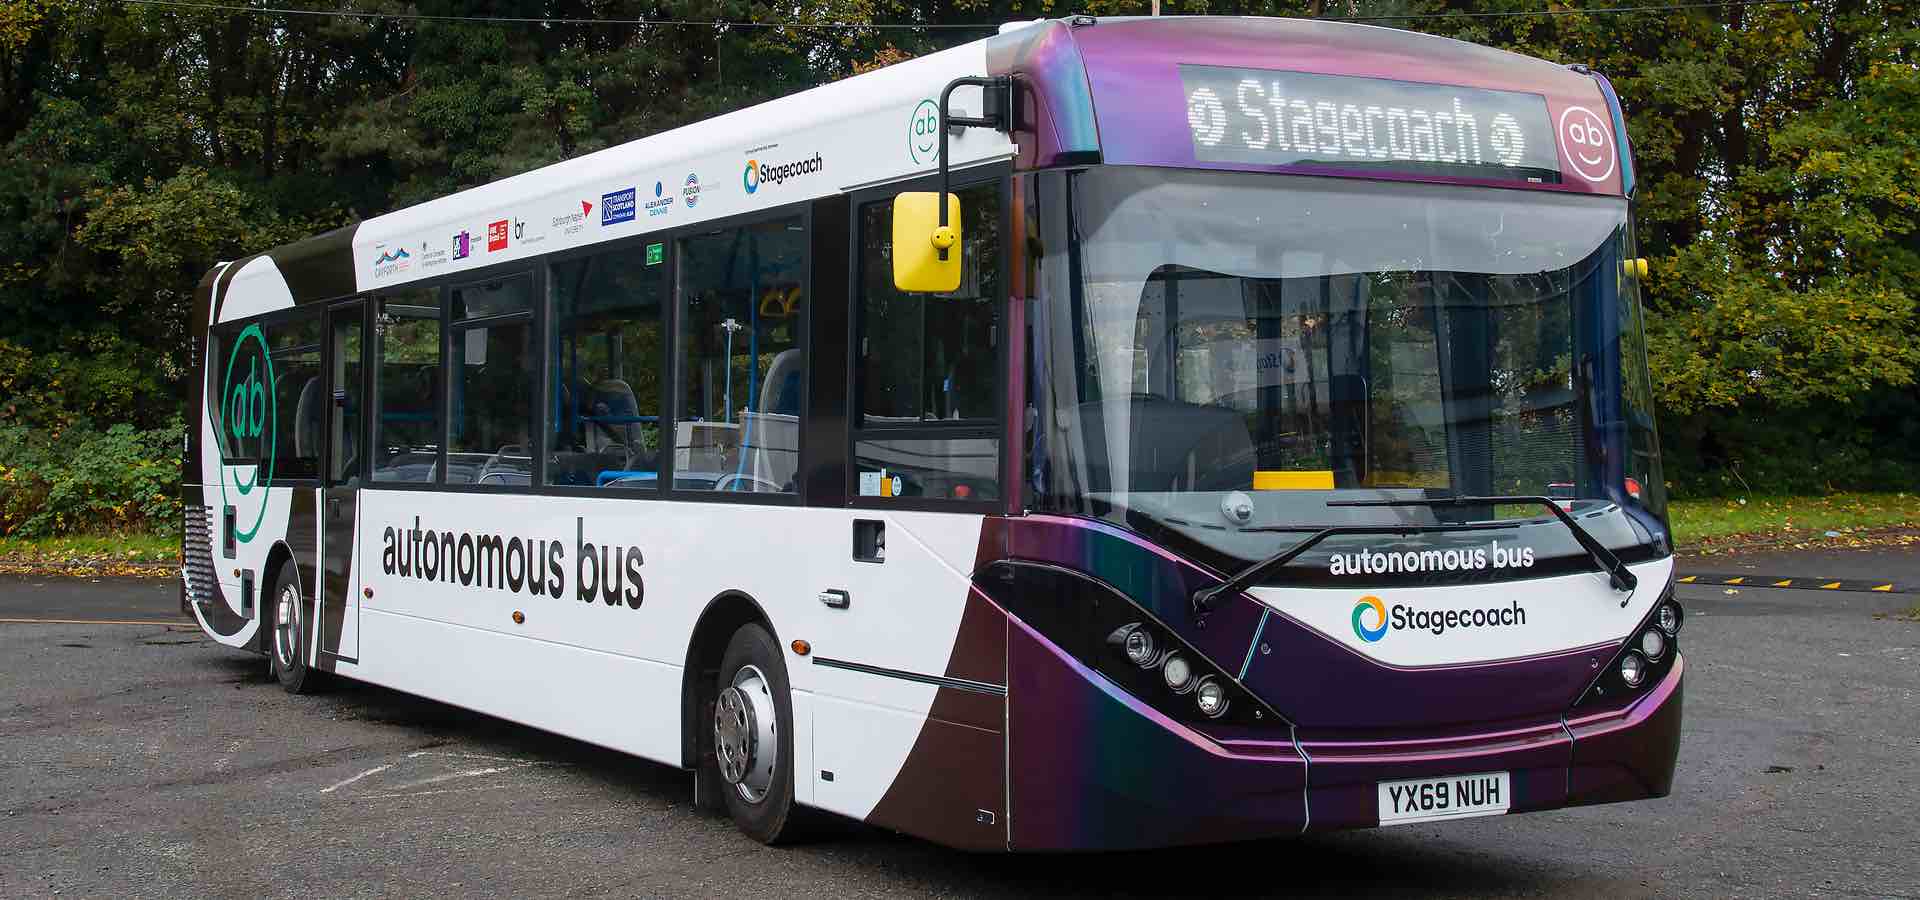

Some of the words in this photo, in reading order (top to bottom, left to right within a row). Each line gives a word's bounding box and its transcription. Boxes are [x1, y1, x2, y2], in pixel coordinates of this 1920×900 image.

[916, 108, 936, 135] ab
[1237, 79, 1481, 164] Stagecoach
[1569, 117, 1603, 147] ab
[760, 151, 822, 184] Stagecoach
[612, 191, 634, 204] TRANSPORT
[612, 200, 634, 210] SCOTLAND
[645, 197, 673, 209] ALEXANDER
[683, 186, 700, 196] FUSION
[650, 206, 668, 216] DENNIS
[231, 355, 265, 438] ab
[383, 516, 565, 599] autonomous
[576, 517, 644, 610] bus
[1330, 548, 1486, 575] autonomous
[1493, 540, 1535, 568] bus
[1391, 600, 1525, 635] Stagecoach
[1389, 782, 1449, 813] YX69
[1456, 777, 1500, 807] NUH
